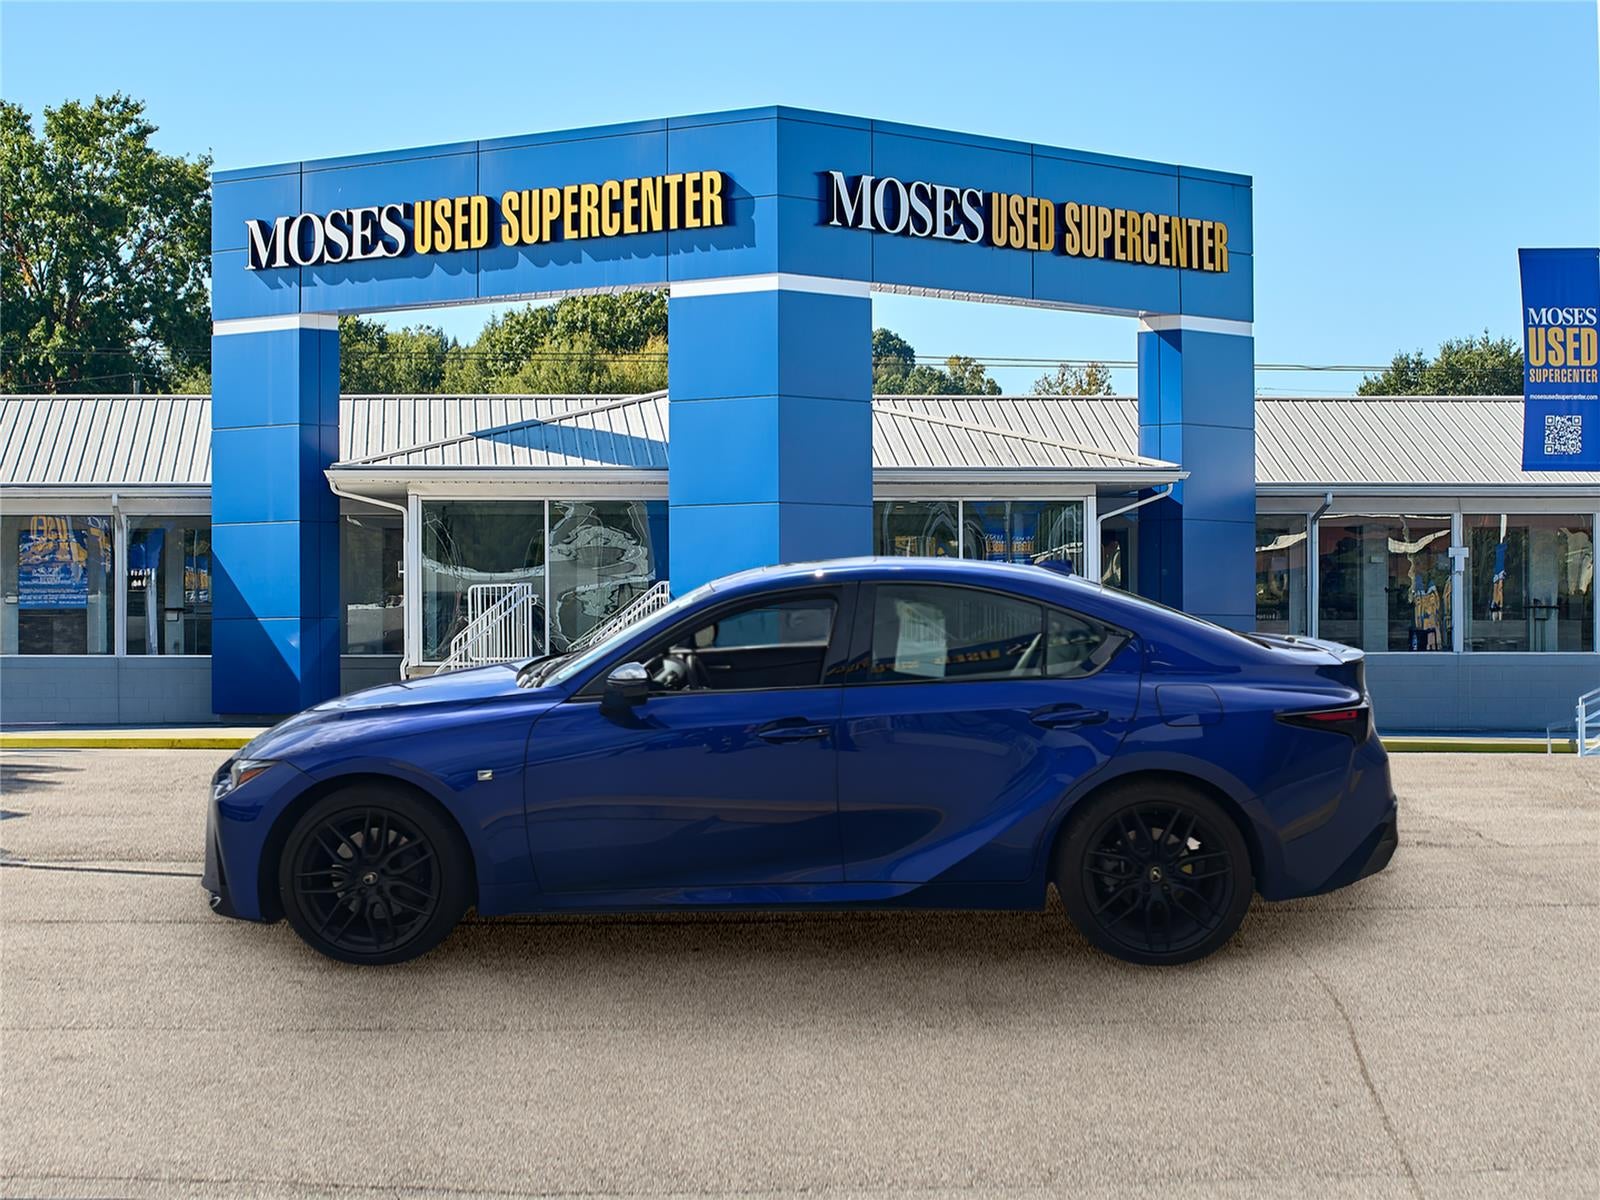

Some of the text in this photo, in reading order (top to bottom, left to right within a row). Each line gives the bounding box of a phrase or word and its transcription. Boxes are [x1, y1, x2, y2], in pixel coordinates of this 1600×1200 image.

[245, 171, 724, 271] MOSES USED SUPERCENTER
[827, 170, 1230, 272] MOSES USED SUPERCENTER
[1527, 307, 1598, 326] MOSES
[1528, 327, 1599, 367] USED
[1529, 368, 1599, 383] SUPERCENTER
